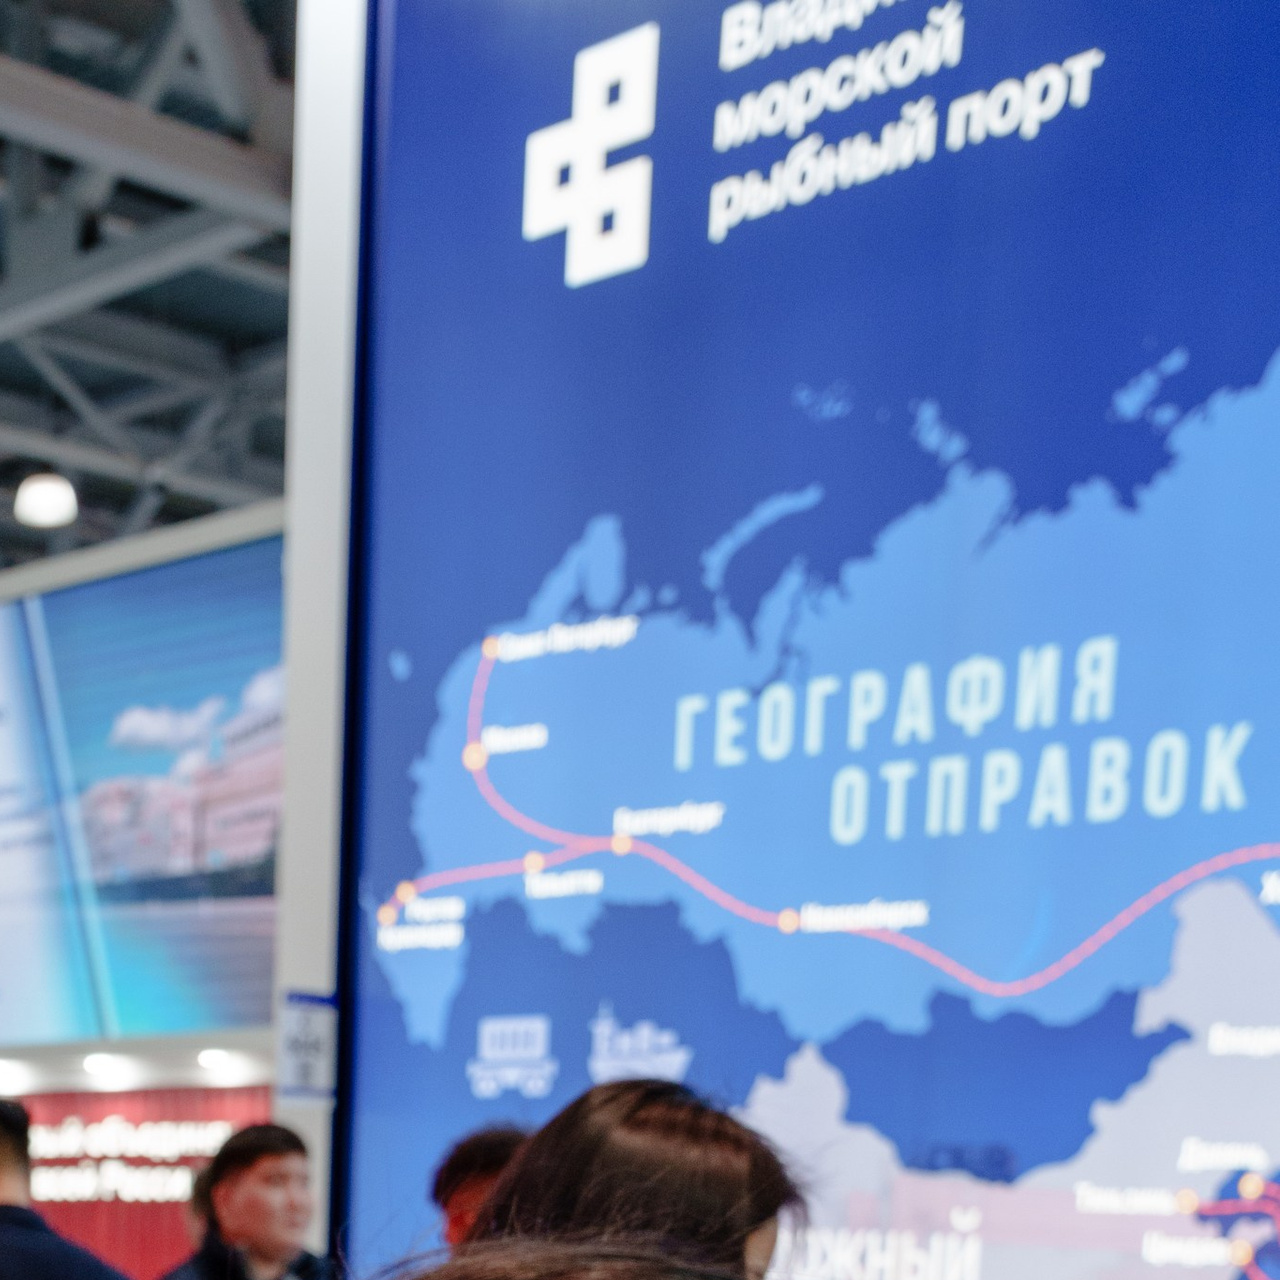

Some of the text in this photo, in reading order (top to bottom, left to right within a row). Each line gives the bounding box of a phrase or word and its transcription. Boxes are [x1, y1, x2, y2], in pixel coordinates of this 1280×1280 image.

[708, 47, 1106, 244] рыбный порт
[712, 0, 965, 152] морской
[673, 634, 1118, 773] ГЕОГРАФИЯ
[829, 719, 1253, 846] ОТПРАВОК
